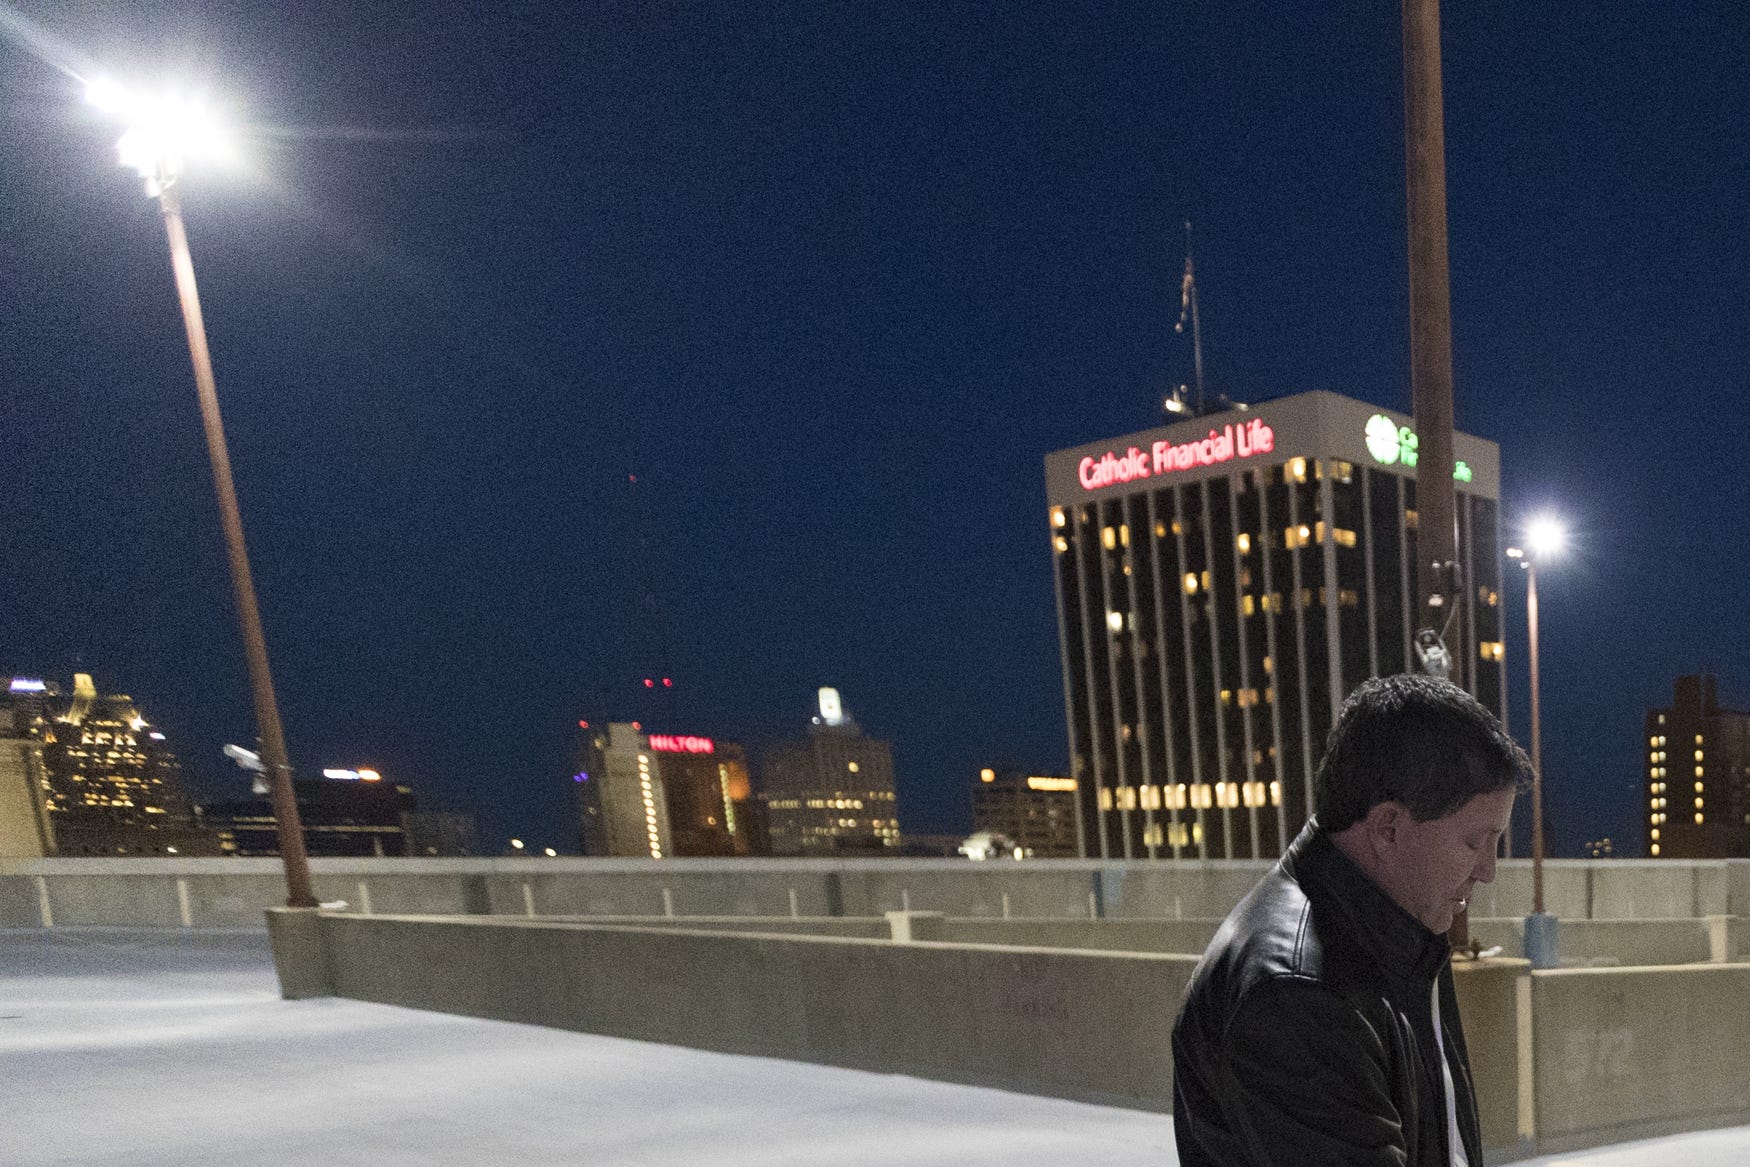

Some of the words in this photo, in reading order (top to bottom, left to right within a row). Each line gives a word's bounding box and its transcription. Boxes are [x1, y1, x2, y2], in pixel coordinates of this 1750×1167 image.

[1078, 447, 1151, 490] Catholic
[1152, 425, 1234, 475] Financial
[1236, 418, 1274, 458] Life
[649, 735, 714, 754] HILTON
